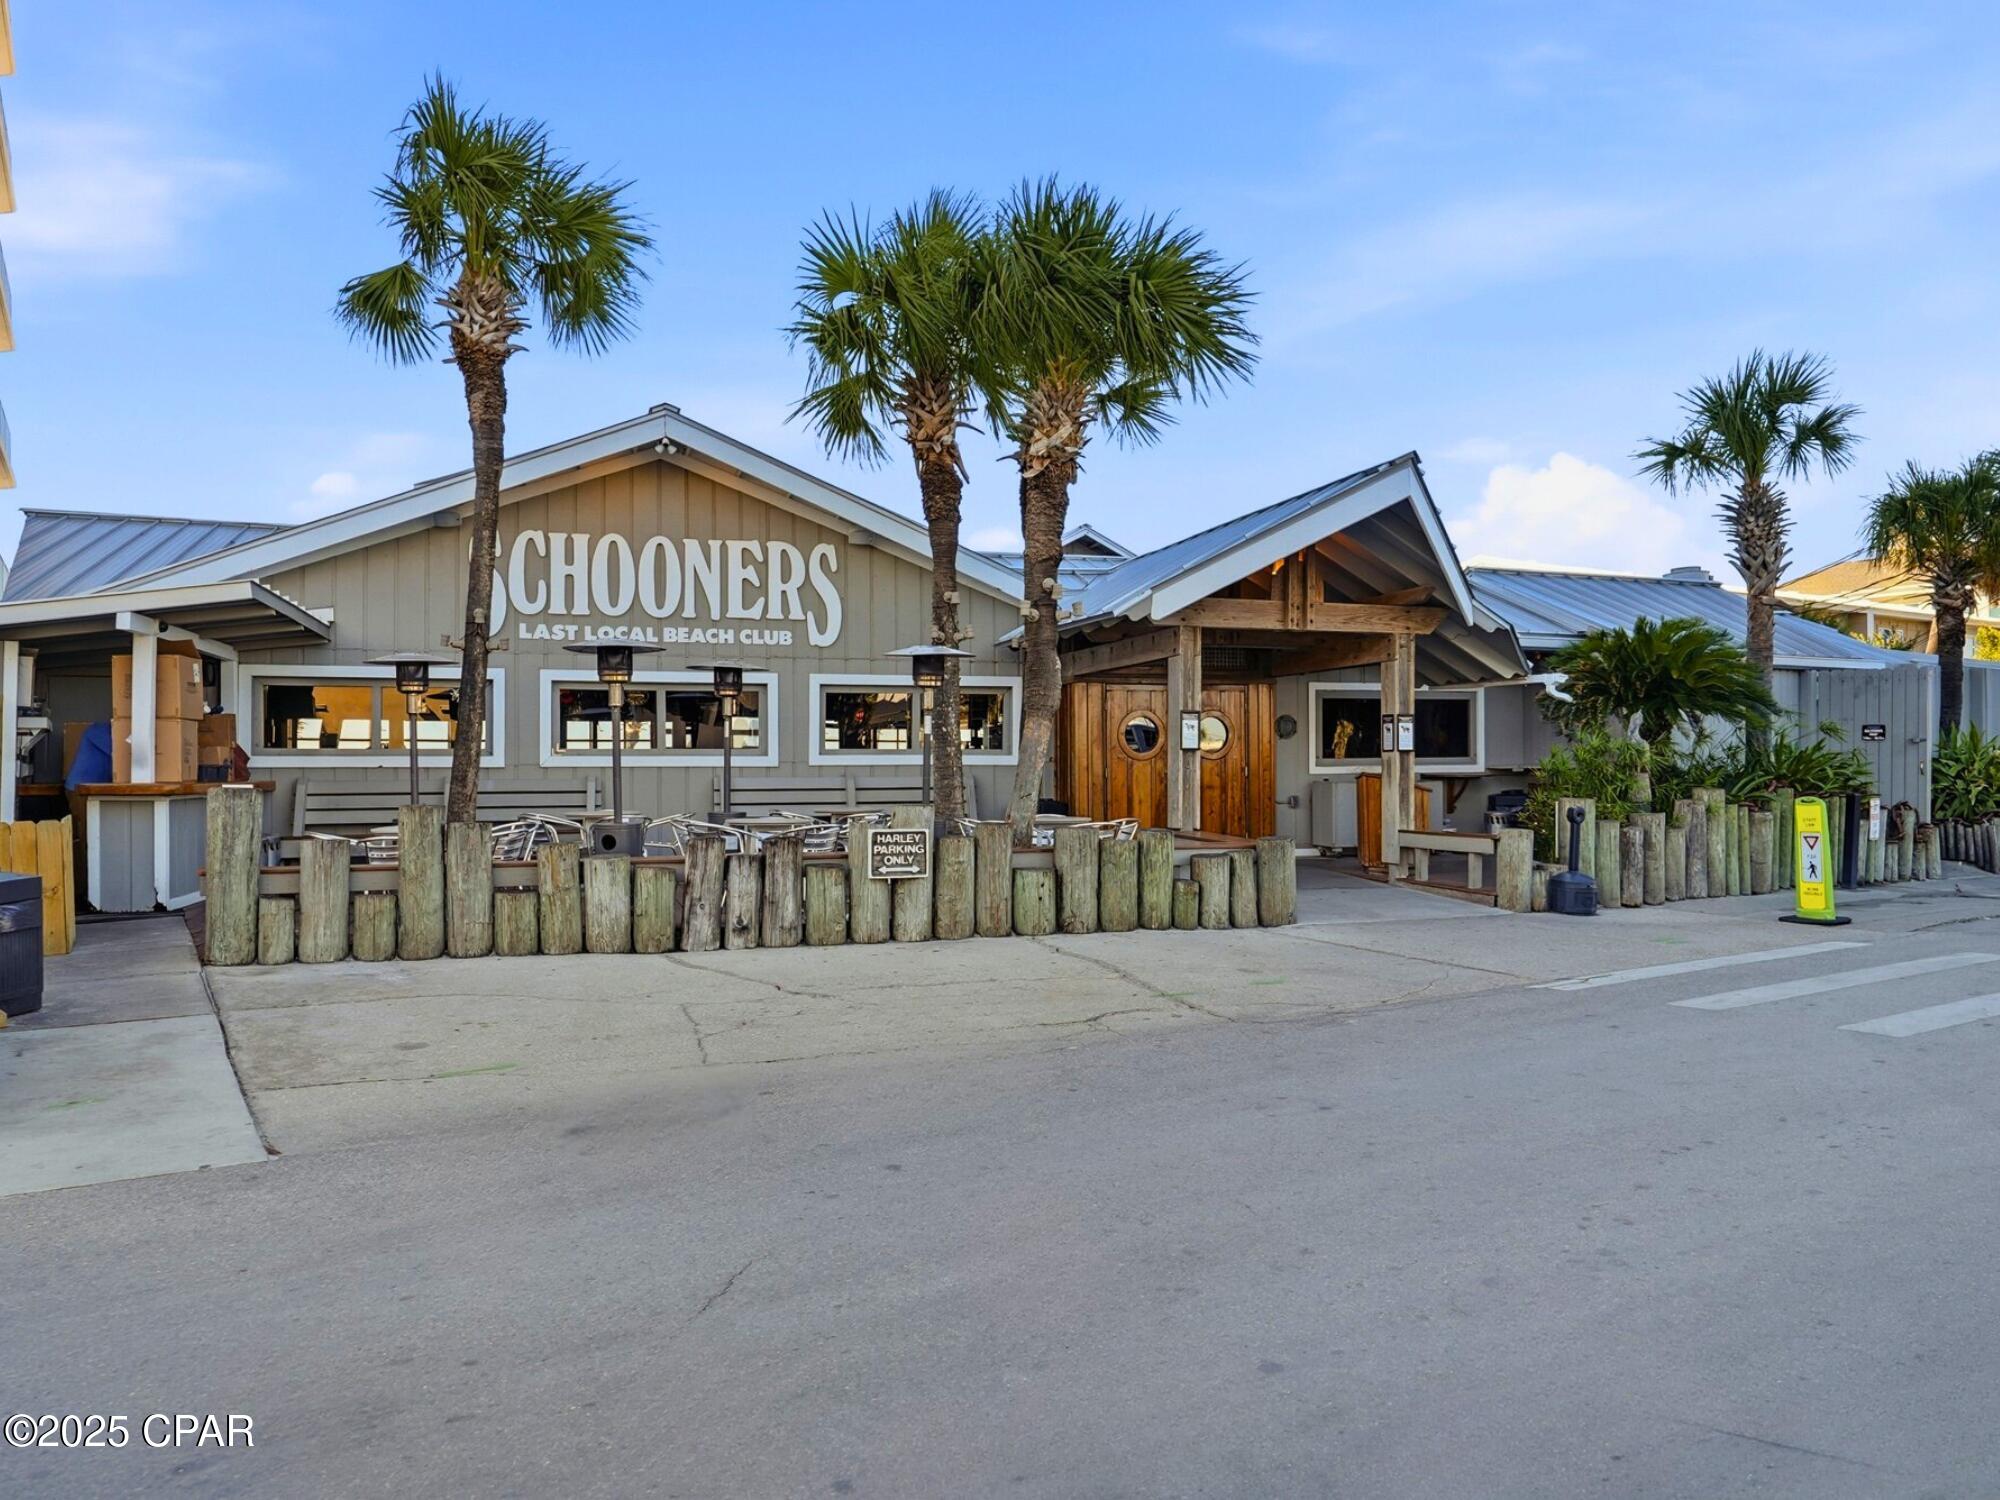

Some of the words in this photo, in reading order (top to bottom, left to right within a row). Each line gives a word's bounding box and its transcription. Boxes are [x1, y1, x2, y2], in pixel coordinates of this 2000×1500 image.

[519, 622, 578, 641] LAST
[584, 625, 658, 642] LOCAL
[663, 627, 734, 644] BEACH
[740, 629, 793, 646] CLUB
[877, 833, 921, 843] HARLEY
[873, 844, 925, 855] PARKING
[884, 855, 914, 866] ONLY
